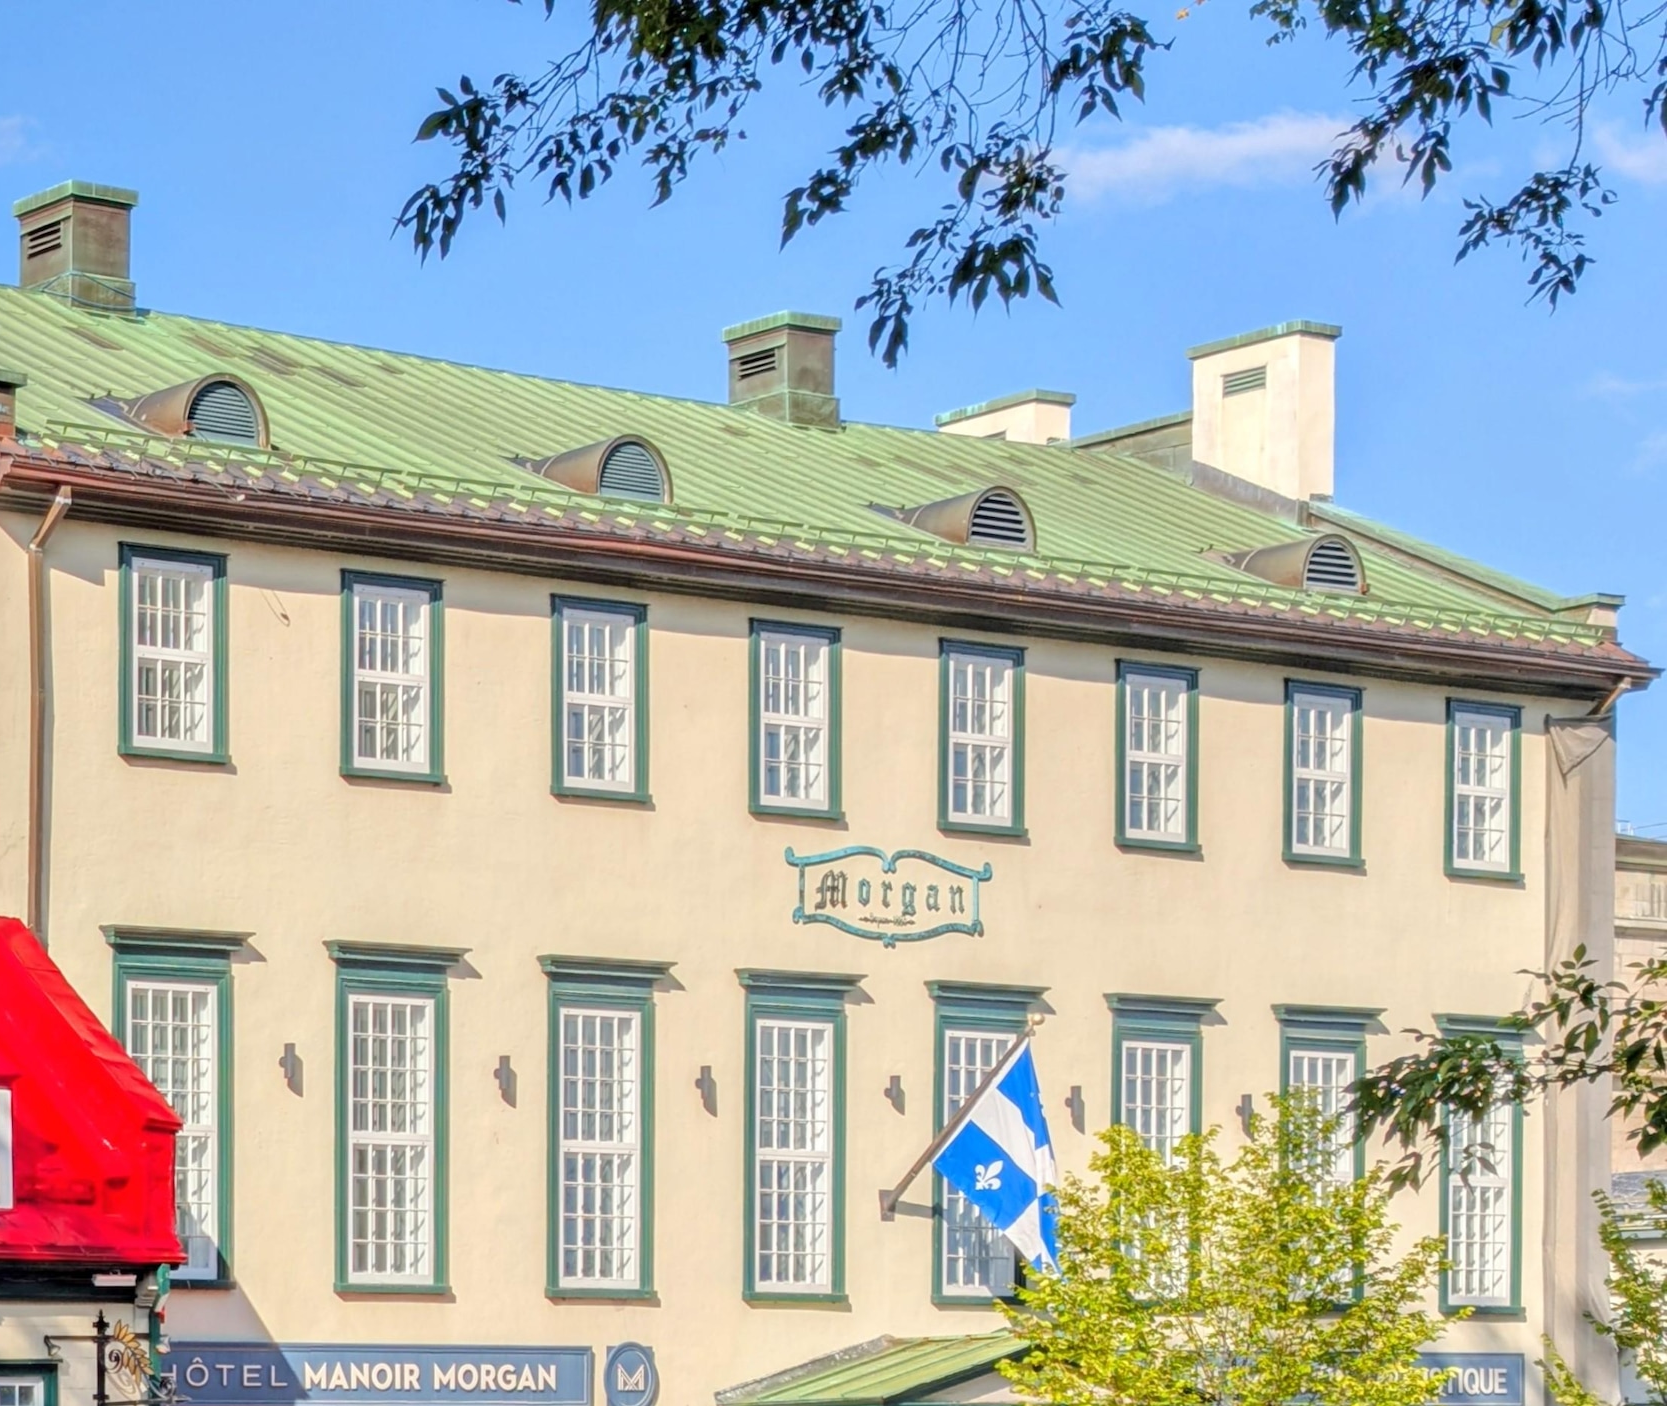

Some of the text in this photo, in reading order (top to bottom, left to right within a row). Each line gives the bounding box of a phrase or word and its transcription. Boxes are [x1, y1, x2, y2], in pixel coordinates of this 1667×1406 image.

[815, 869, 965, 917] Morgan
[304, 1361, 420, 1391] MANOIR
[432, 1362, 558, 1392] MORGAN
